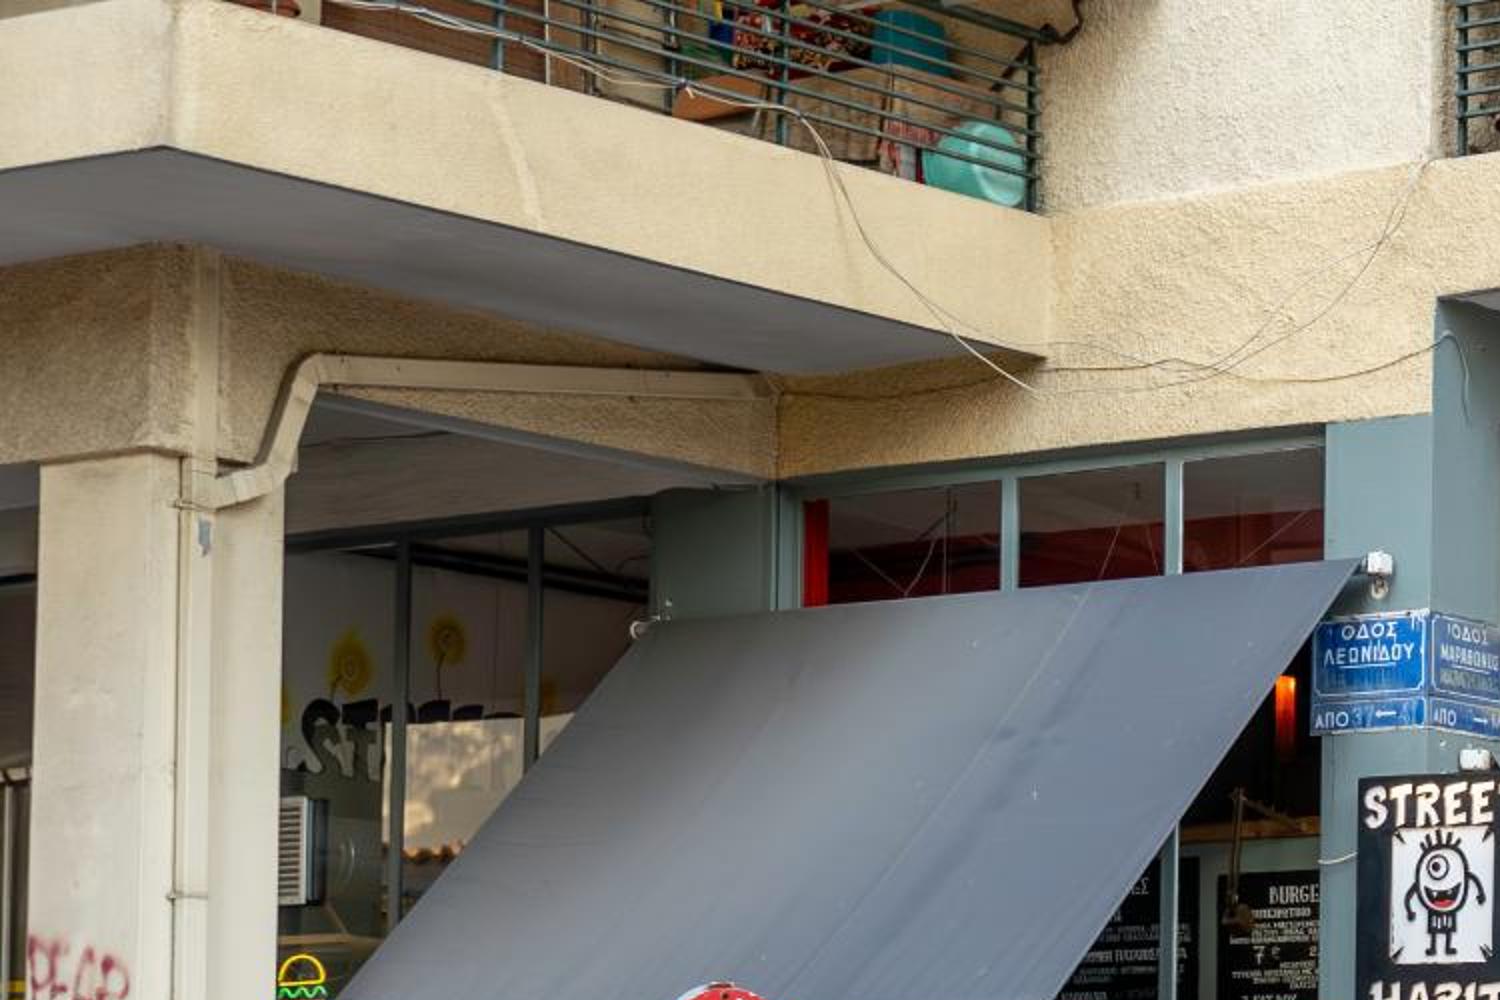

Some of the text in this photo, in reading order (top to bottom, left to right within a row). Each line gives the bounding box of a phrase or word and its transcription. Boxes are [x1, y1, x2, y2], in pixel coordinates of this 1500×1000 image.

[1341, 622, 1398, 640] ΟΔΟΣ
[1323, 643, 1415, 667] ΛΕΩΝΙΔΟΥ
[1315, 711, 1349, 729] ΑΠΟ
